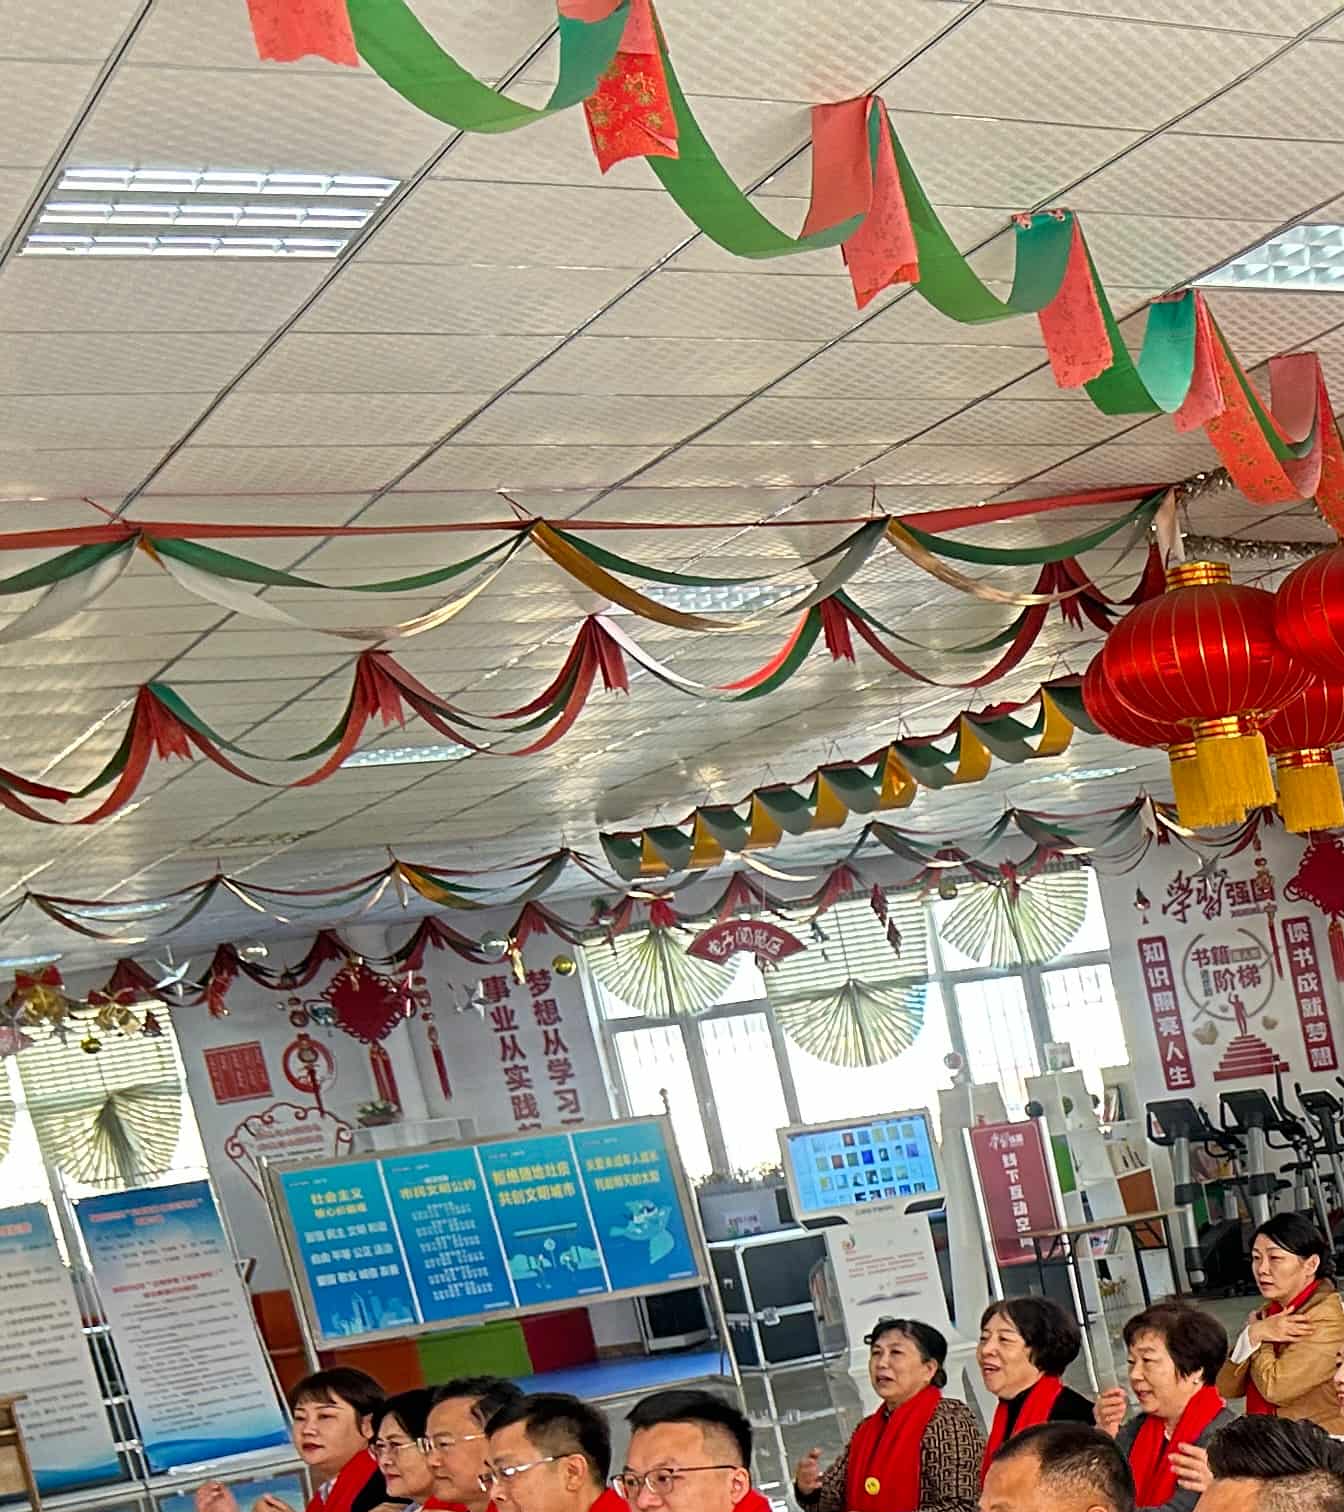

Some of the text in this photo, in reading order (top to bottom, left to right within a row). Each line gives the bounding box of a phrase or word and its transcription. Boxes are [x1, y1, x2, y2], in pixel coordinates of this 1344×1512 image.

[481, 976, 542, 1131] 事业从实践
[526, 968, 584, 1124] 梦想从学习
[1142, 942, 1191, 1086] 知识照亮人生
[1288, 922, 1334, 1067] 读书成就梦想
